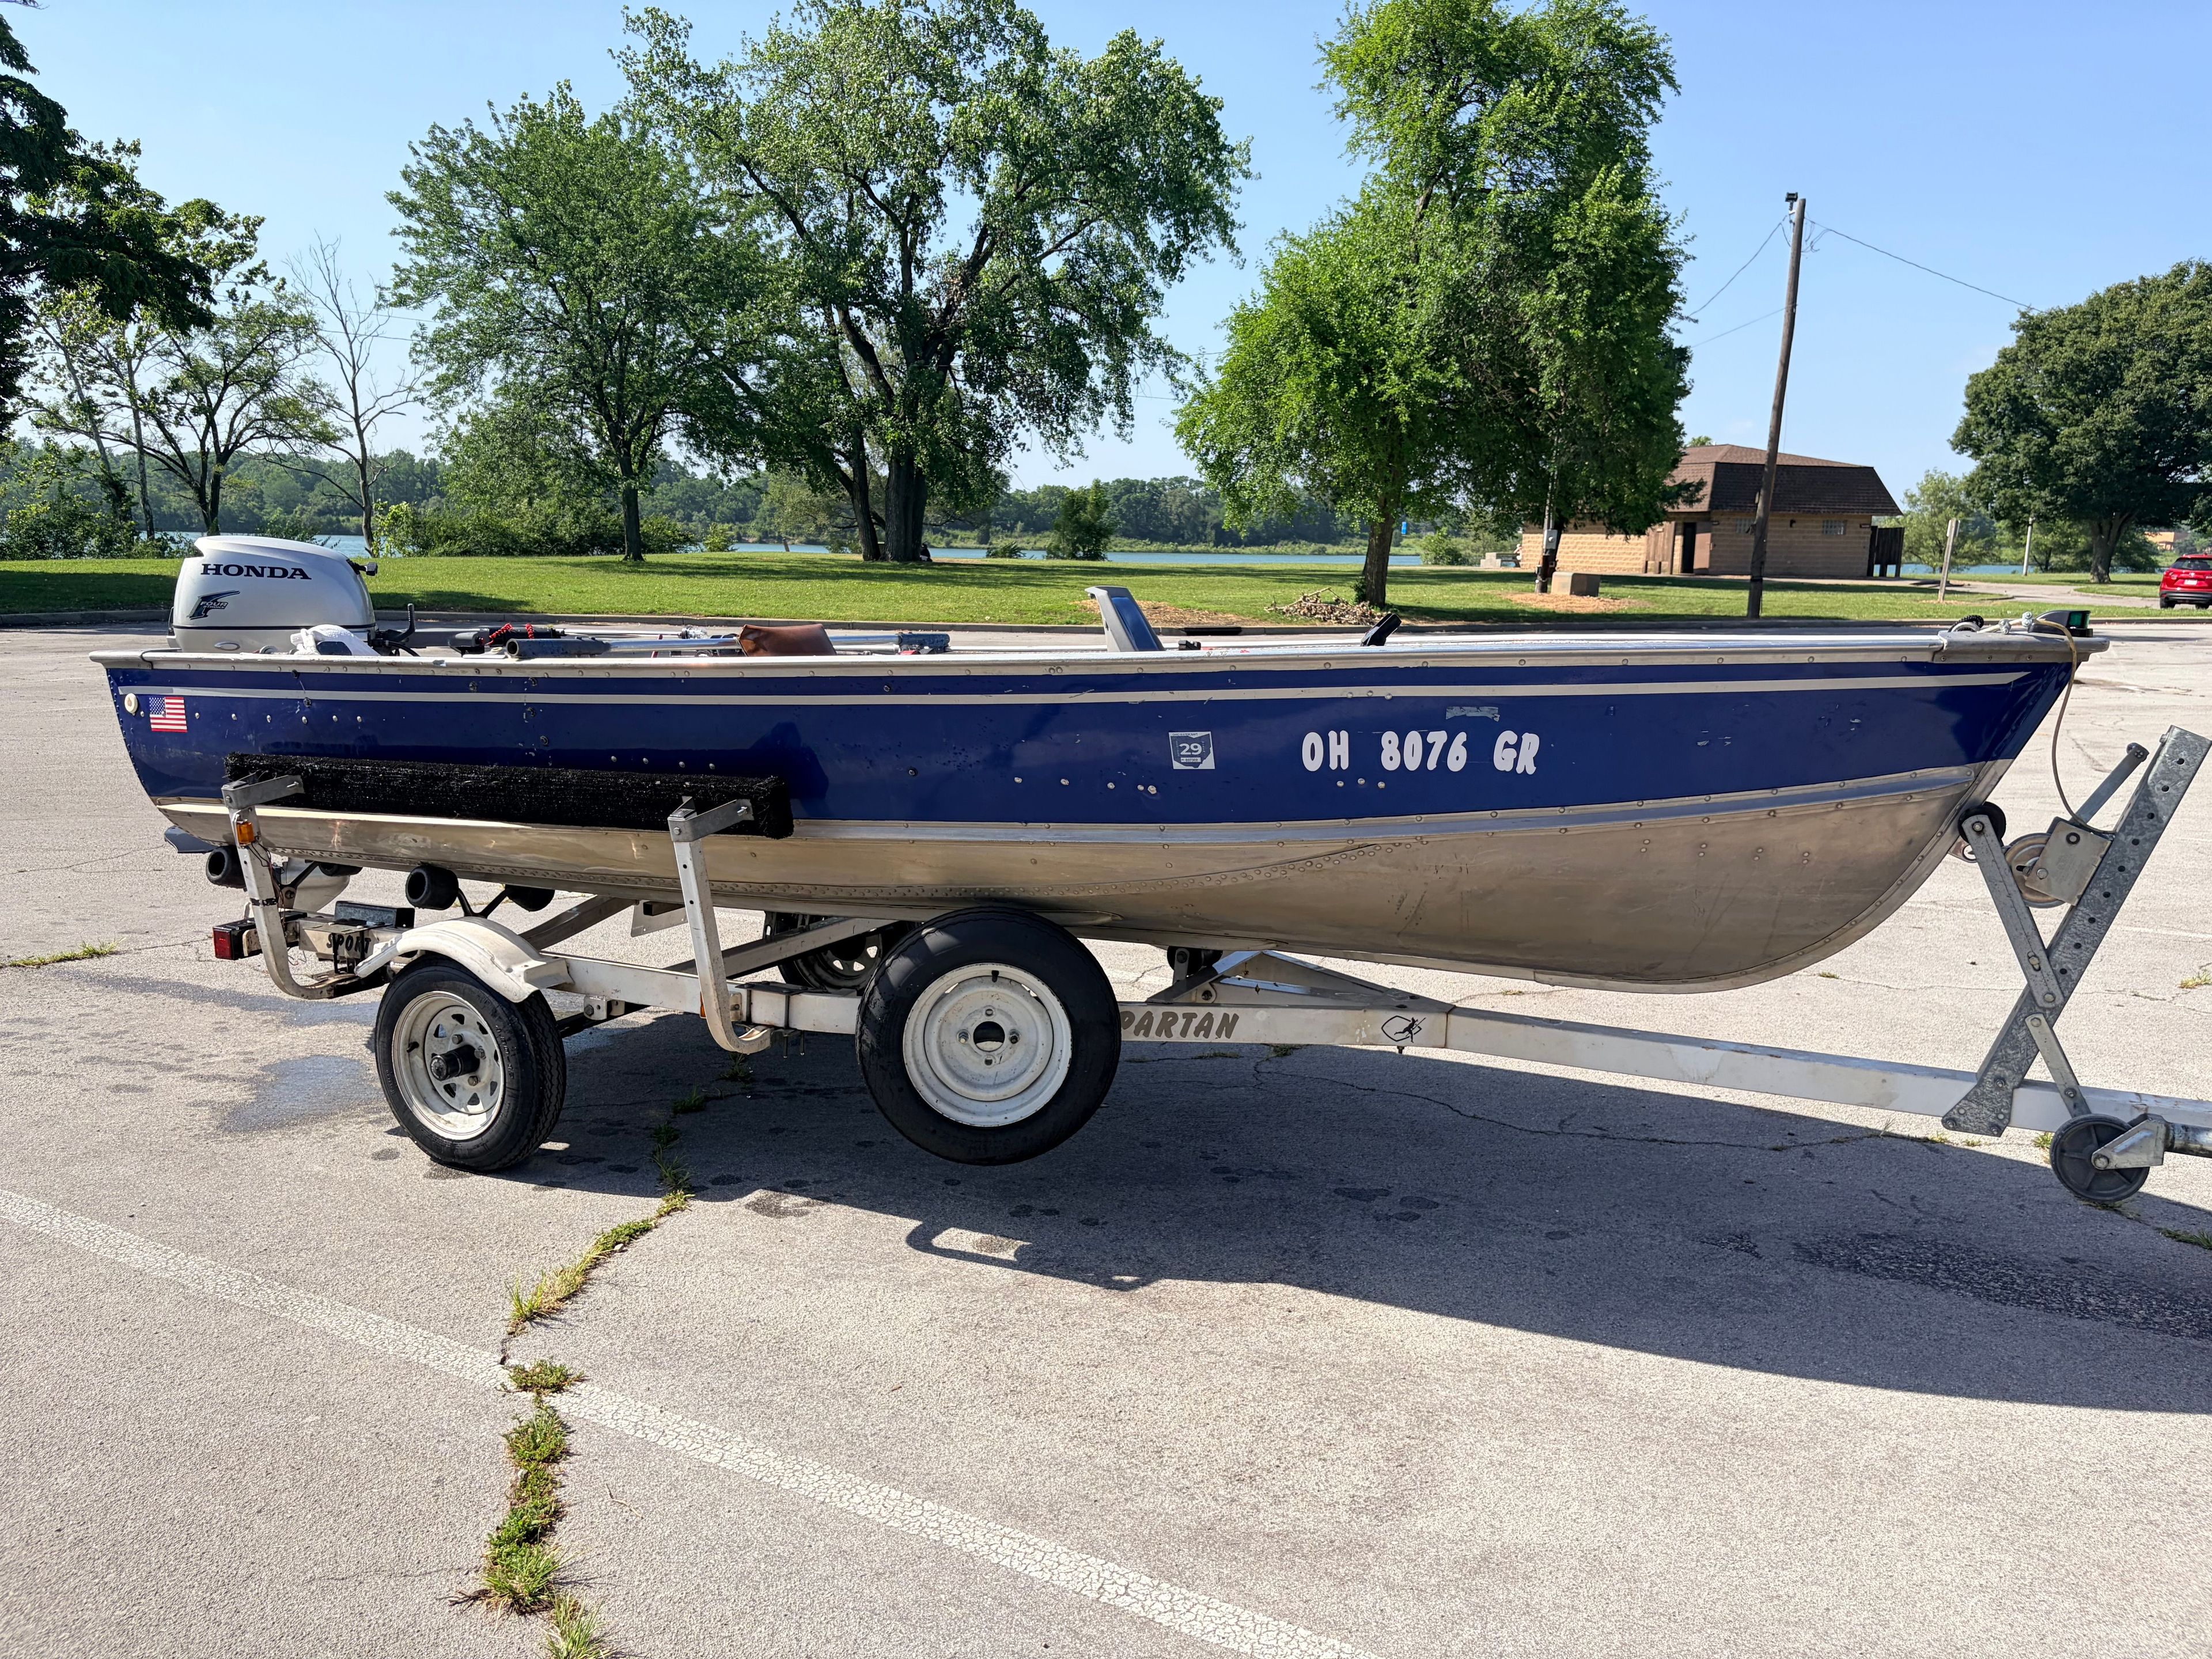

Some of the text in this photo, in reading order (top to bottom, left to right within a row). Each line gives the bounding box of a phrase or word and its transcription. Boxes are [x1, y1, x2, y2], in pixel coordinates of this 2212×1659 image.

[200, 563, 312, 580] HONDA
[1179, 743, 1202, 755] 29
[1302, 730, 1540, 775] OH 8076 GR
[1120, 1010, 1240, 1039] PARTAN
